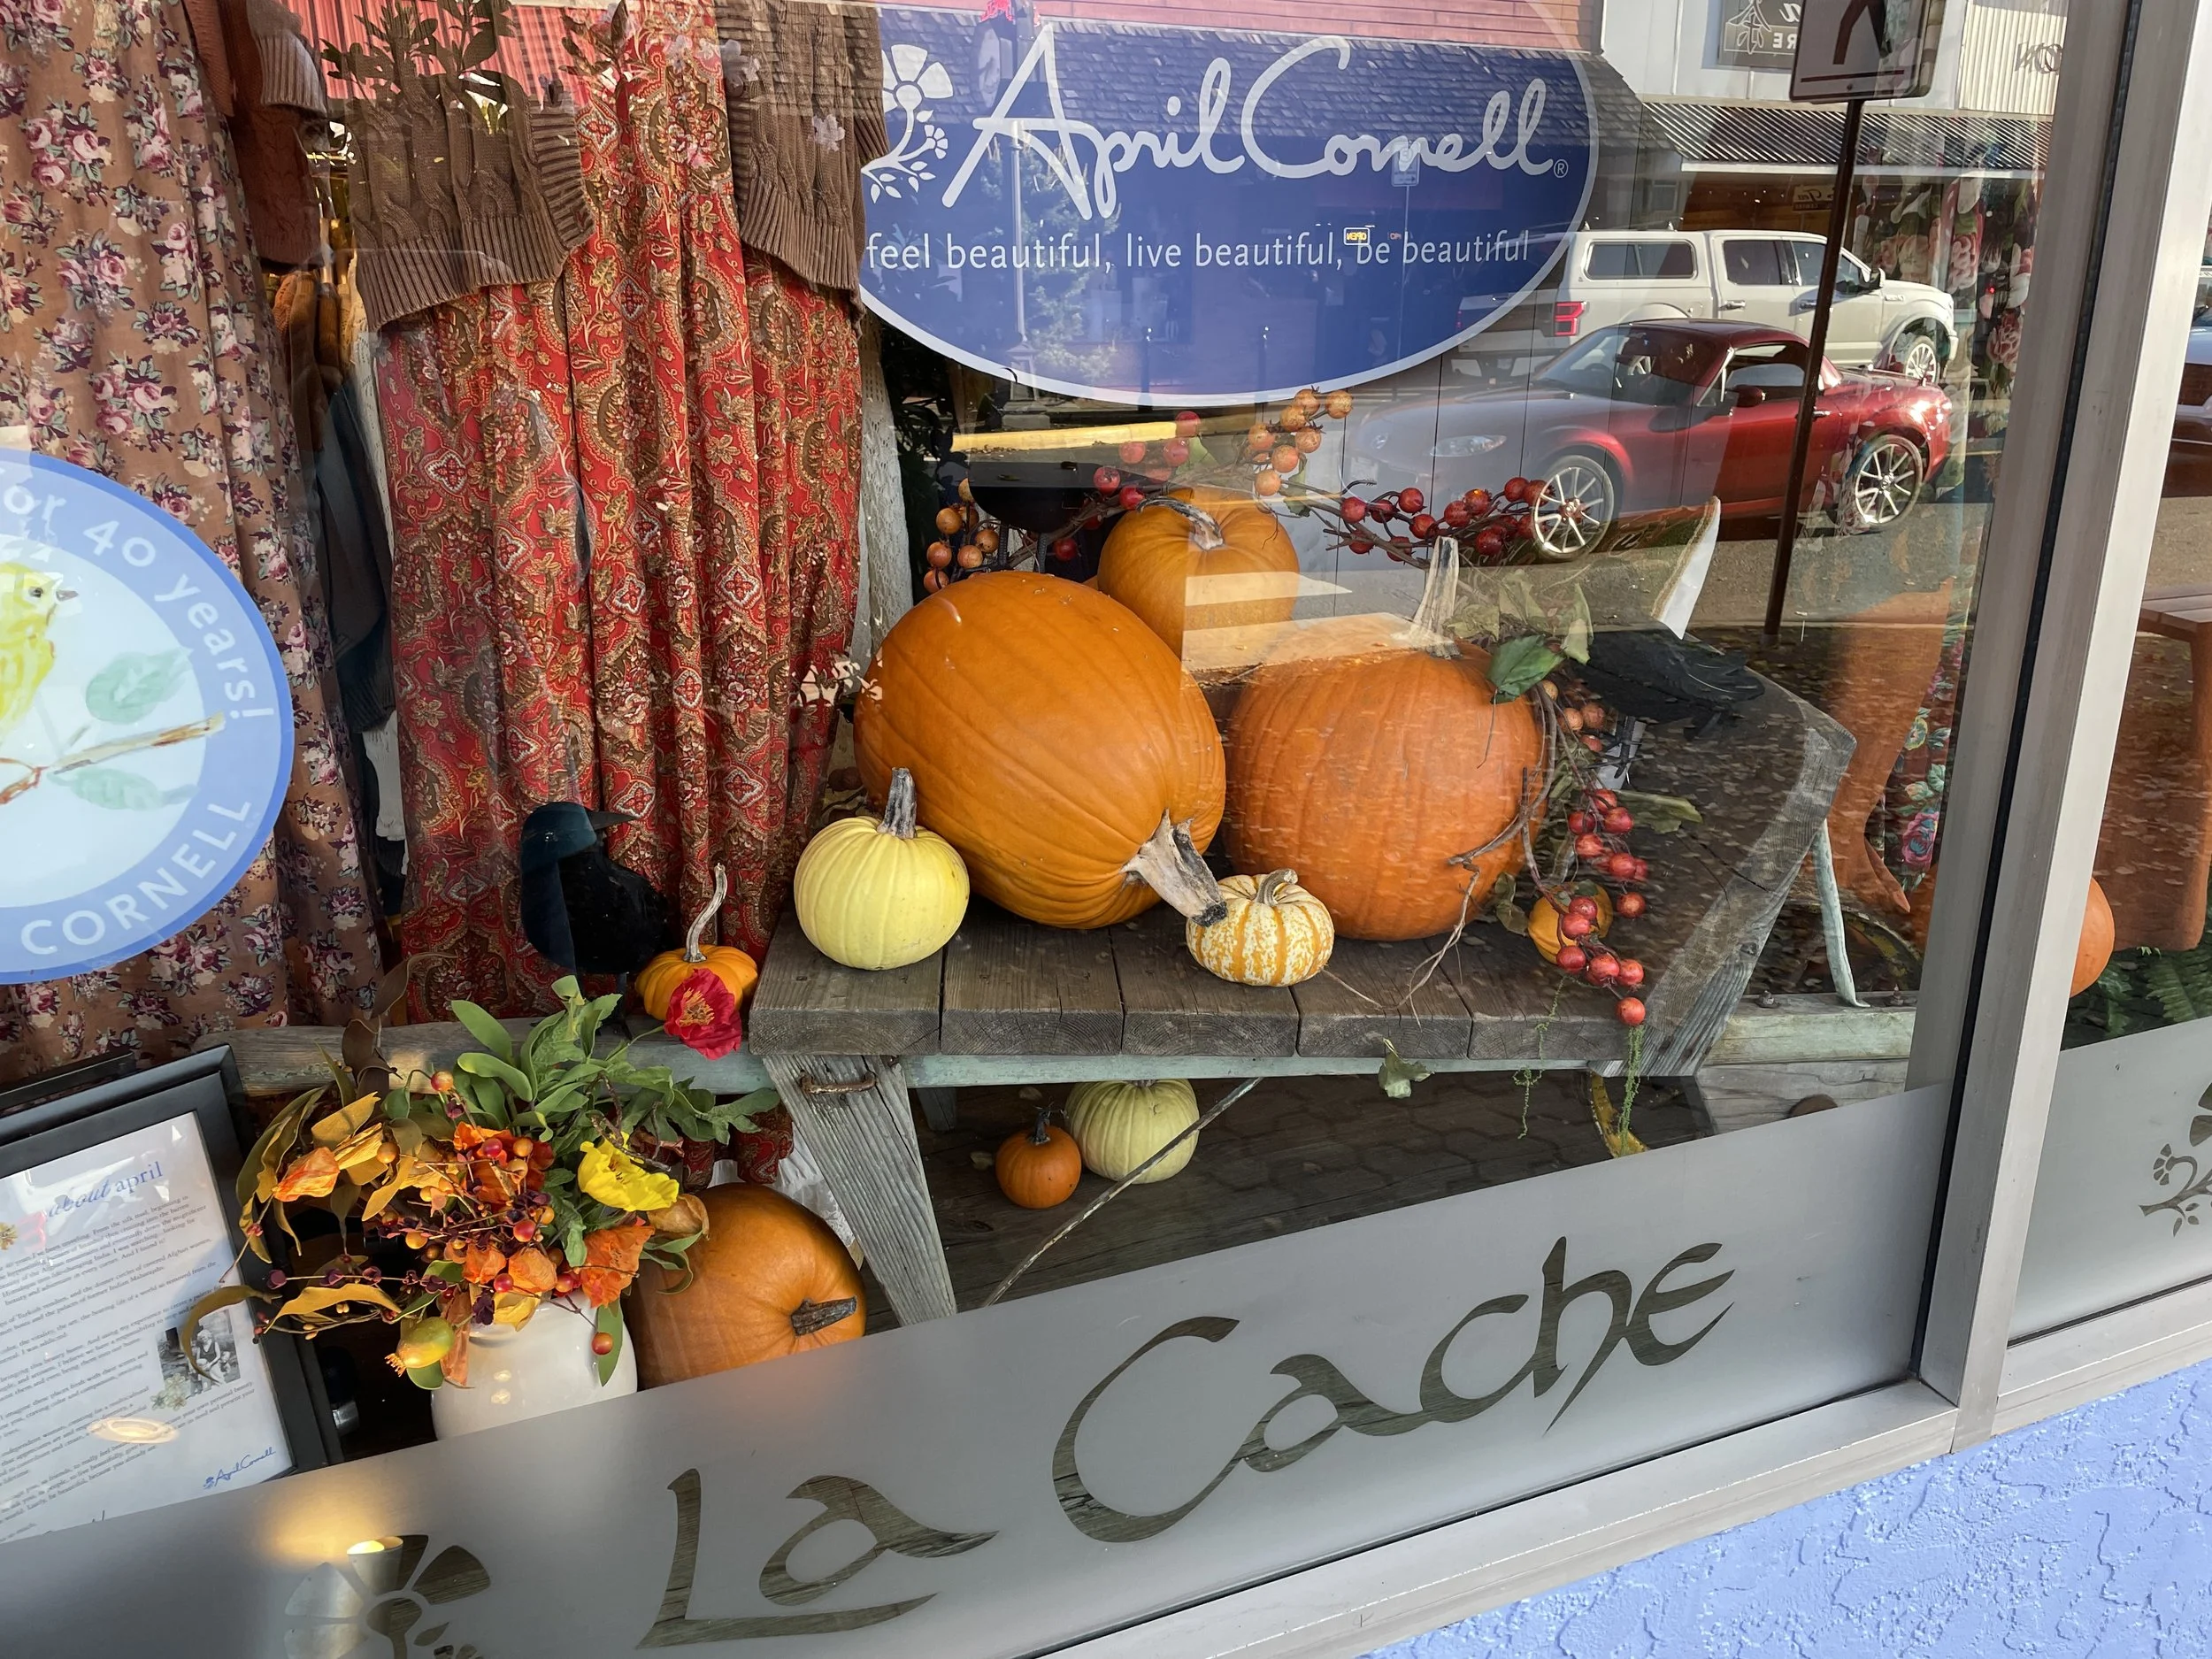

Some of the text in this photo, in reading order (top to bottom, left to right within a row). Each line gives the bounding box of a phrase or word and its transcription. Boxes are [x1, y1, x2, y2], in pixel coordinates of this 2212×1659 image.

[942, 24, 1553, 220] April Cornell
[867, 229, 1529, 273] feel beautiful, live beautiful, be beautiful
[0, 468, 275, 721] or 40 years!
[20, 797, 252, 956] CORNELL
[116, 1161, 163, 1194] april
[635, 1235, 1736, 1649] La Cache
